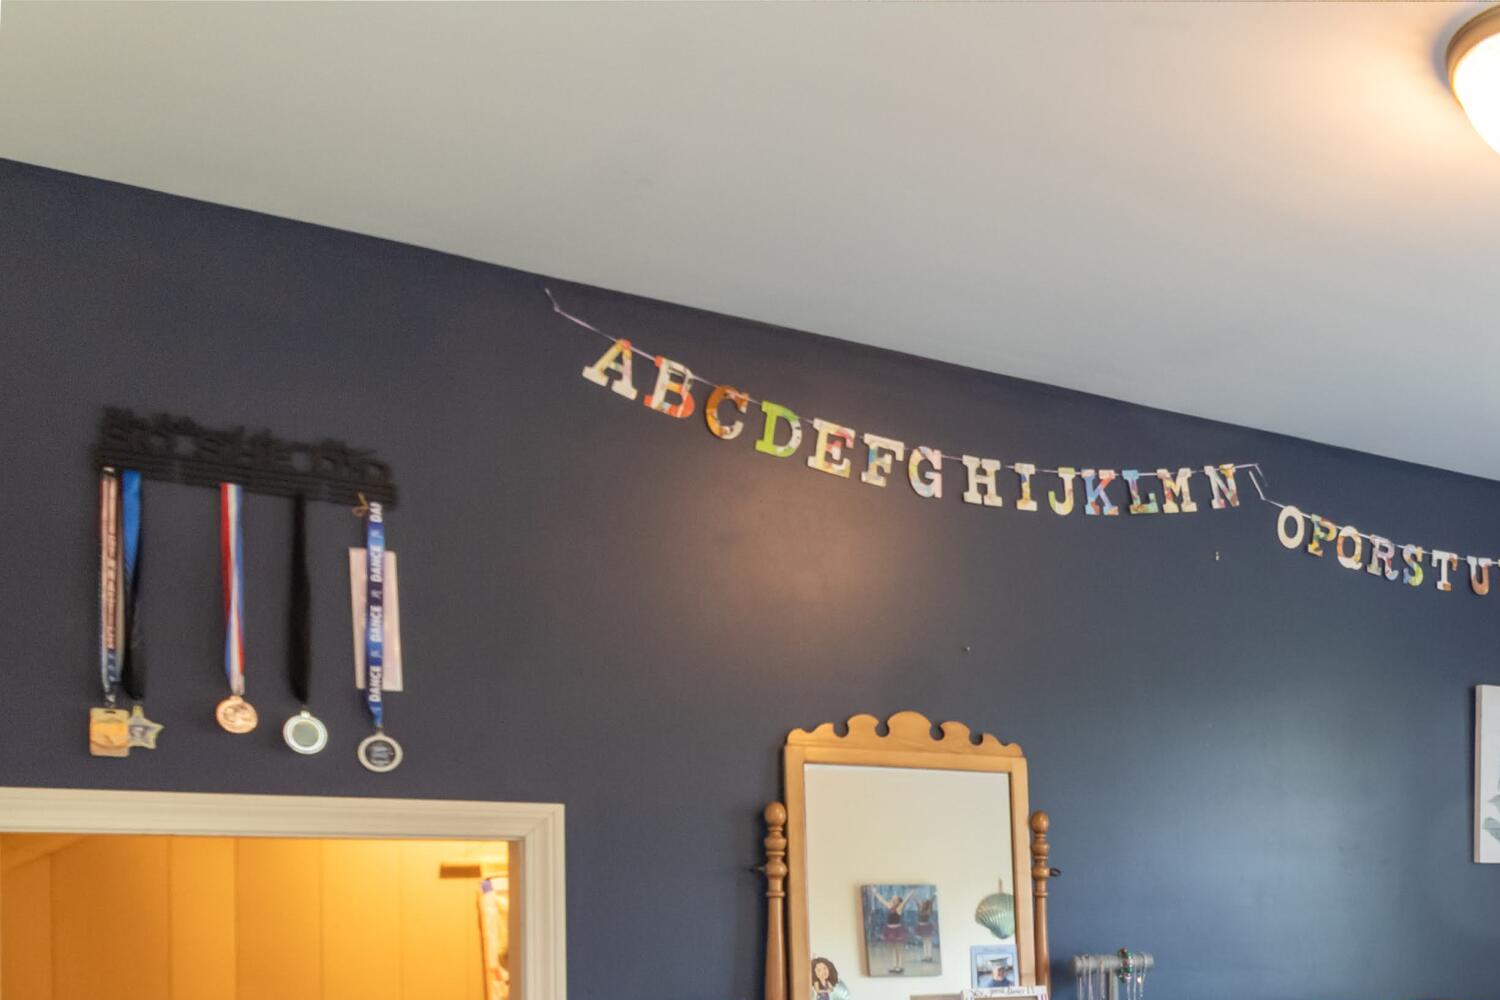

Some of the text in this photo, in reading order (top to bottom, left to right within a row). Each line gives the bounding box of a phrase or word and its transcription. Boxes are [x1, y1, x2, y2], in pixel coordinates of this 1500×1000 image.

[370, 545, 384, 582] DANCE
[370, 605, 383, 643] DANCE
[368, 665, 382, 702] DANCE
